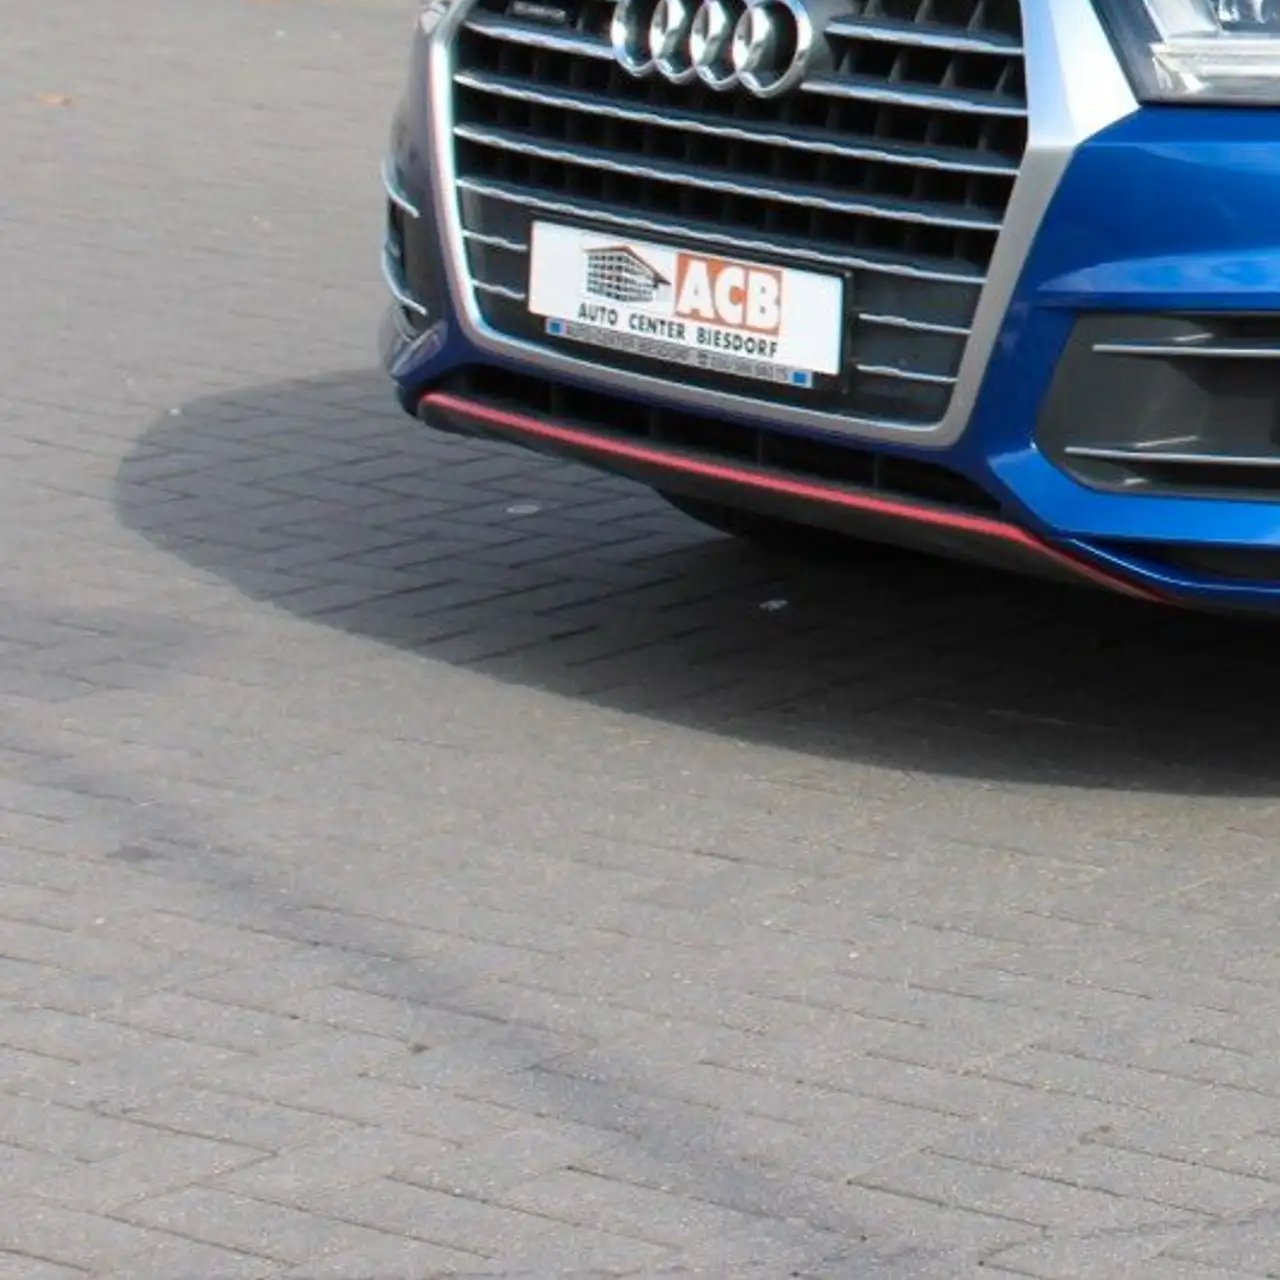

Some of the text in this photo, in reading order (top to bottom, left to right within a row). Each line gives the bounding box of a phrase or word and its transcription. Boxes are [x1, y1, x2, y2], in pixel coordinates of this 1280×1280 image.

[677, 258, 781, 331] ACB
[578, 302, 619, 326] AUTO
[628, 312, 686, 341] CENTER
[695, 326, 779, 358] BIESDORF
